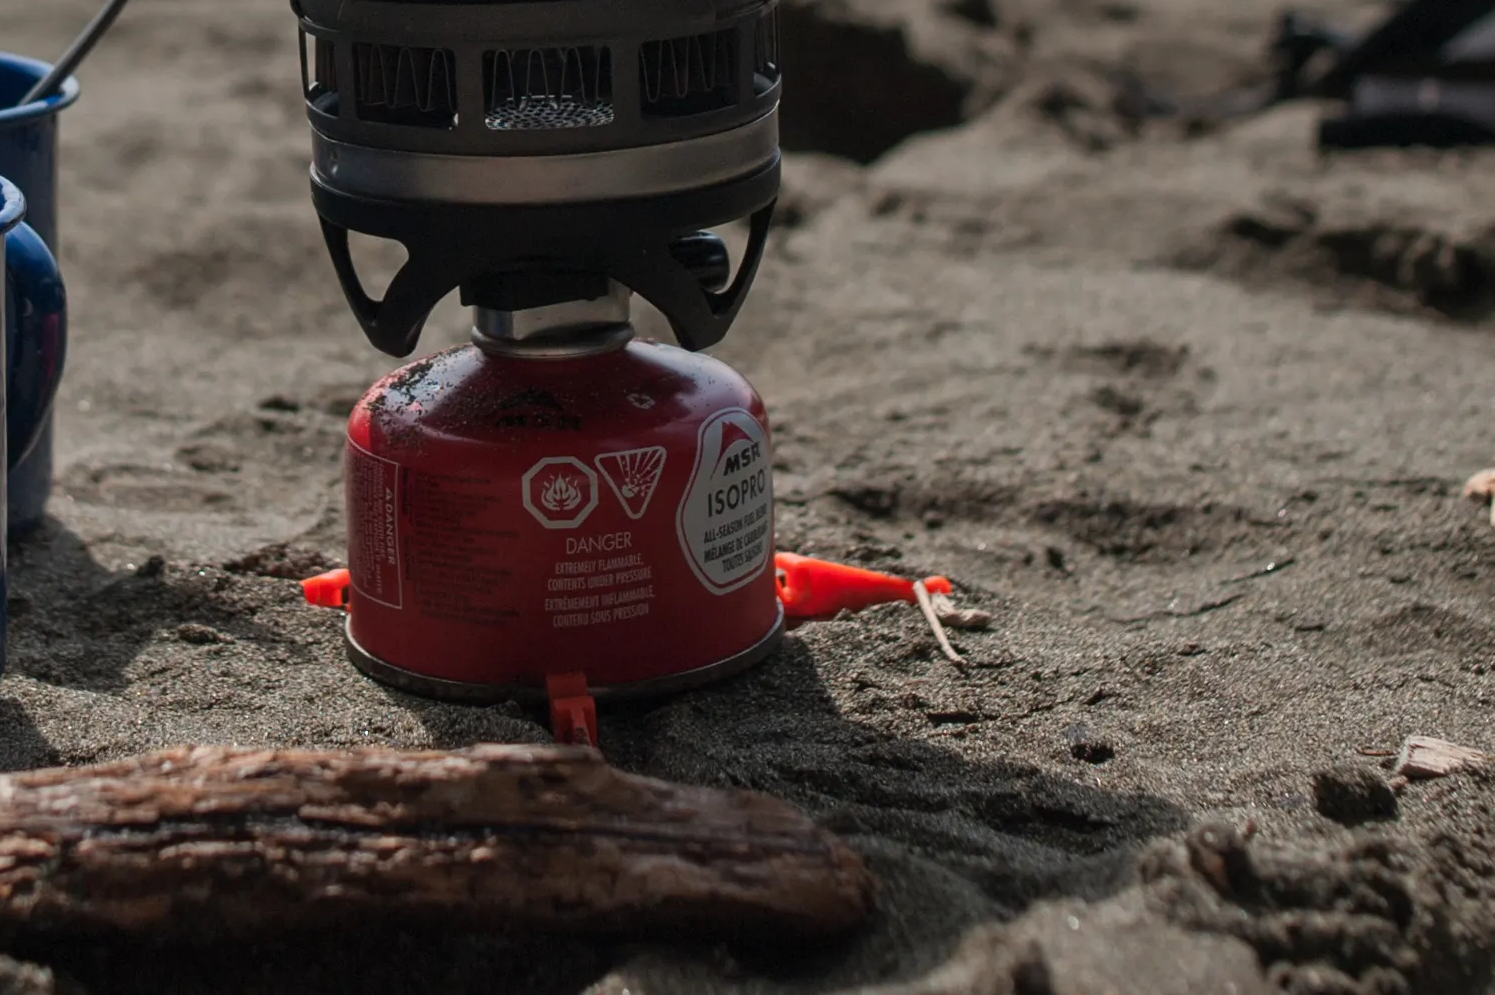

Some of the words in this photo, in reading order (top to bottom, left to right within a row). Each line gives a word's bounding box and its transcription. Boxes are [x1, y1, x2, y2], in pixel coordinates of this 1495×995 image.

[723, 442, 761, 477] MSR
[707, 468, 766, 518] ISOPRO
[386, 503, 395, 565] DANGER
[565, 531, 633, 555] DANGER
[547, 577, 586, 591] CONTENTS
[615, 566, 652, 584] PRESSURE
[555, 559, 597, 575] EXTREMELY
